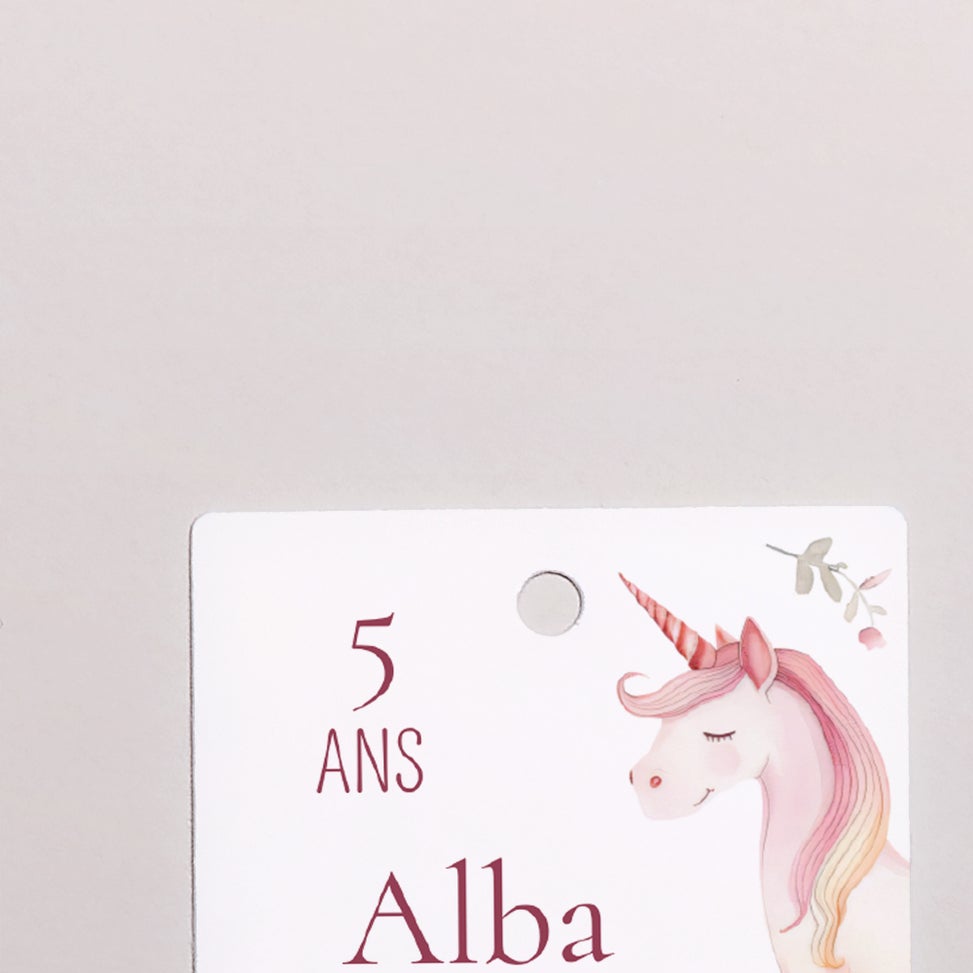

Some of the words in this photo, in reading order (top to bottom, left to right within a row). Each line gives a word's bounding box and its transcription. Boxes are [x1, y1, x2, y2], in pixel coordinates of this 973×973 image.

[352, 612, 395, 712] 5
[316, 727, 424, 794] ANS
[342, 857, 615, 966] Alba
